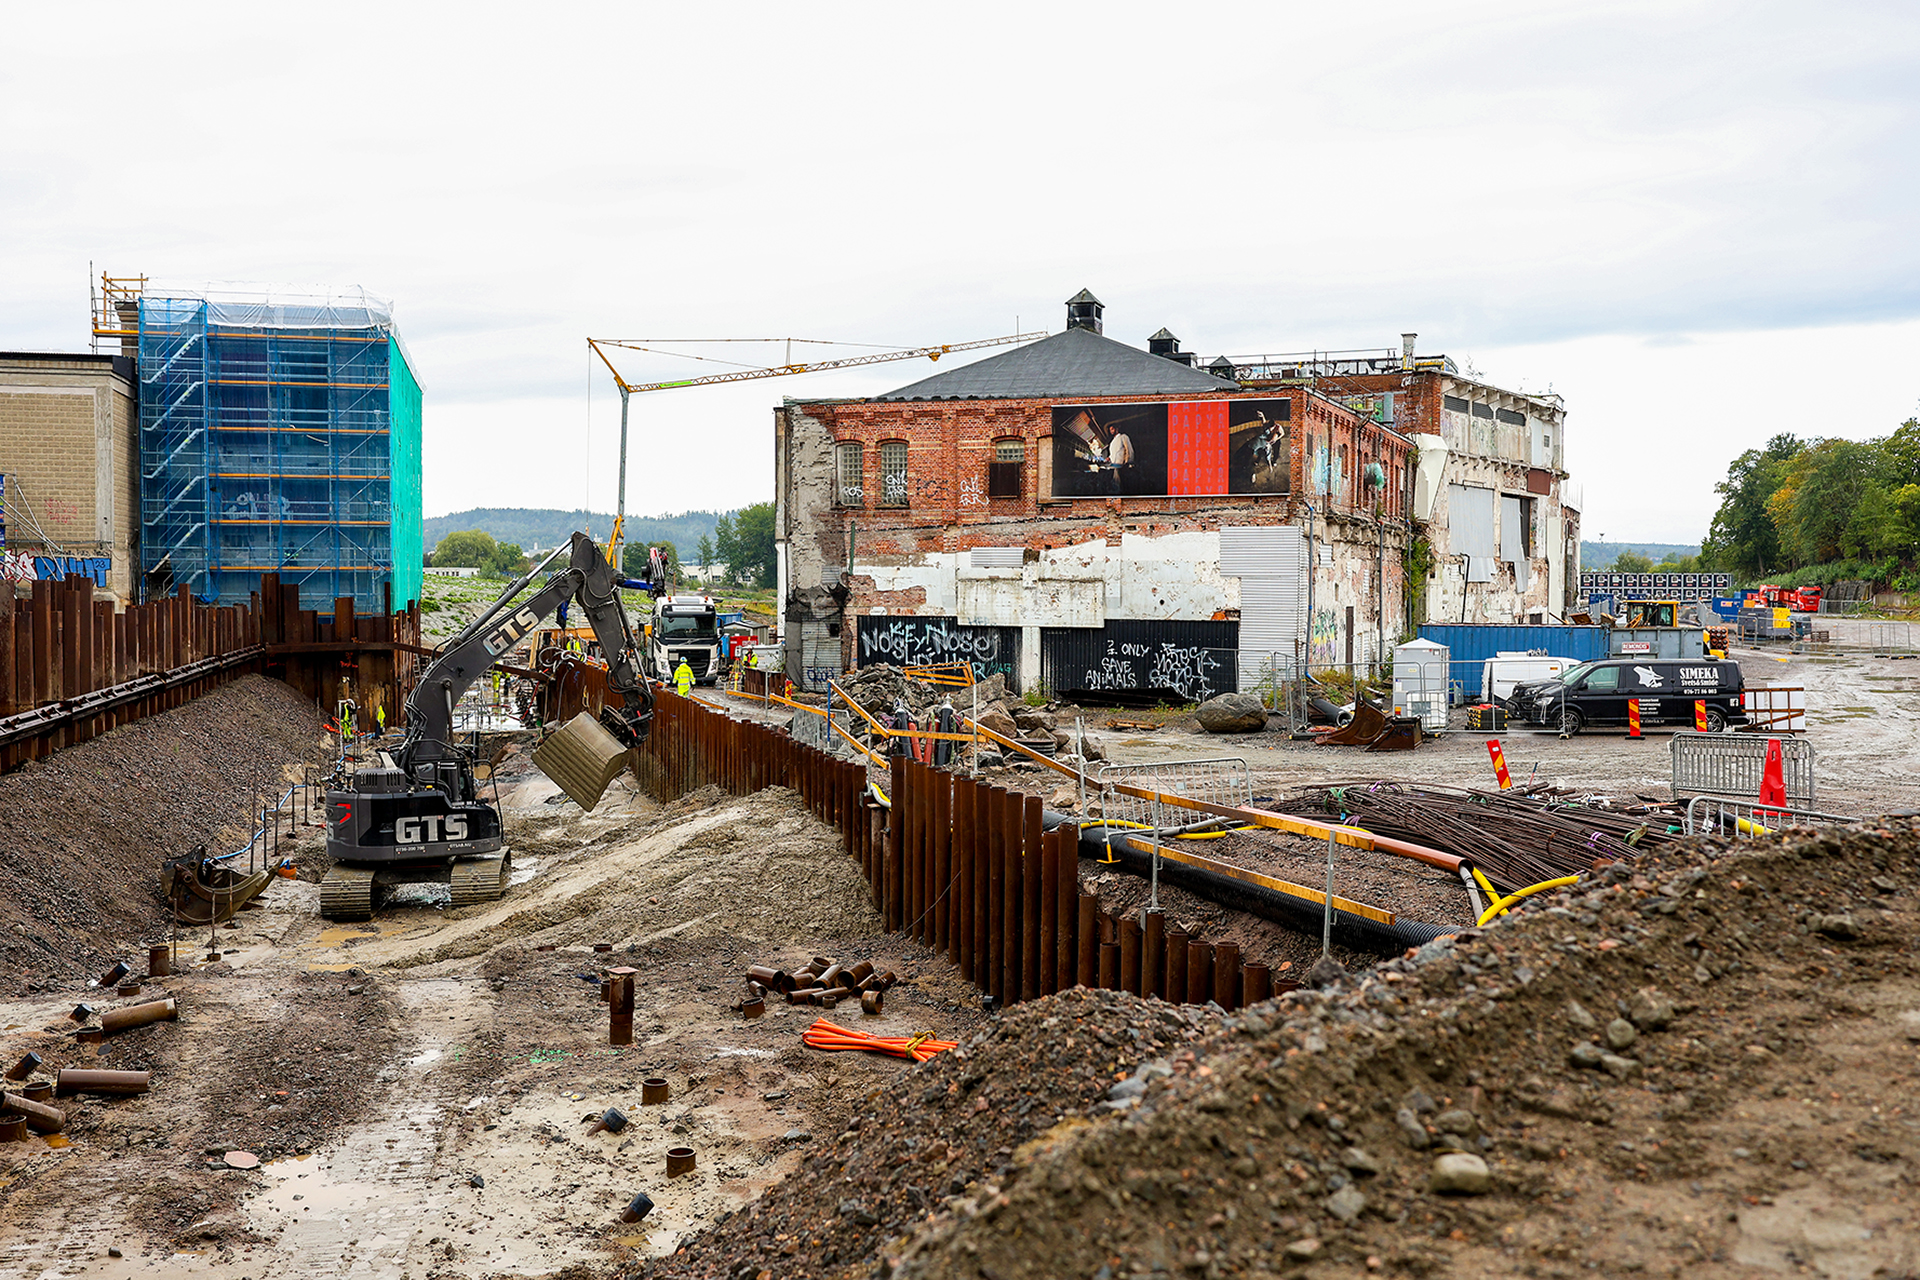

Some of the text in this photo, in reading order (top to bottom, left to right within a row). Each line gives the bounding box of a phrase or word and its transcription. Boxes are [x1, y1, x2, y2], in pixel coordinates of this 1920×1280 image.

[482, 606, 539, 656] GTS
[1121, 643, 1150, 657] ONLY
[1101, 657, 1132, 674] SAVE
[1679, 667, 1719, 679] SIMEKA
[395, 813, 468, 844] GTS
